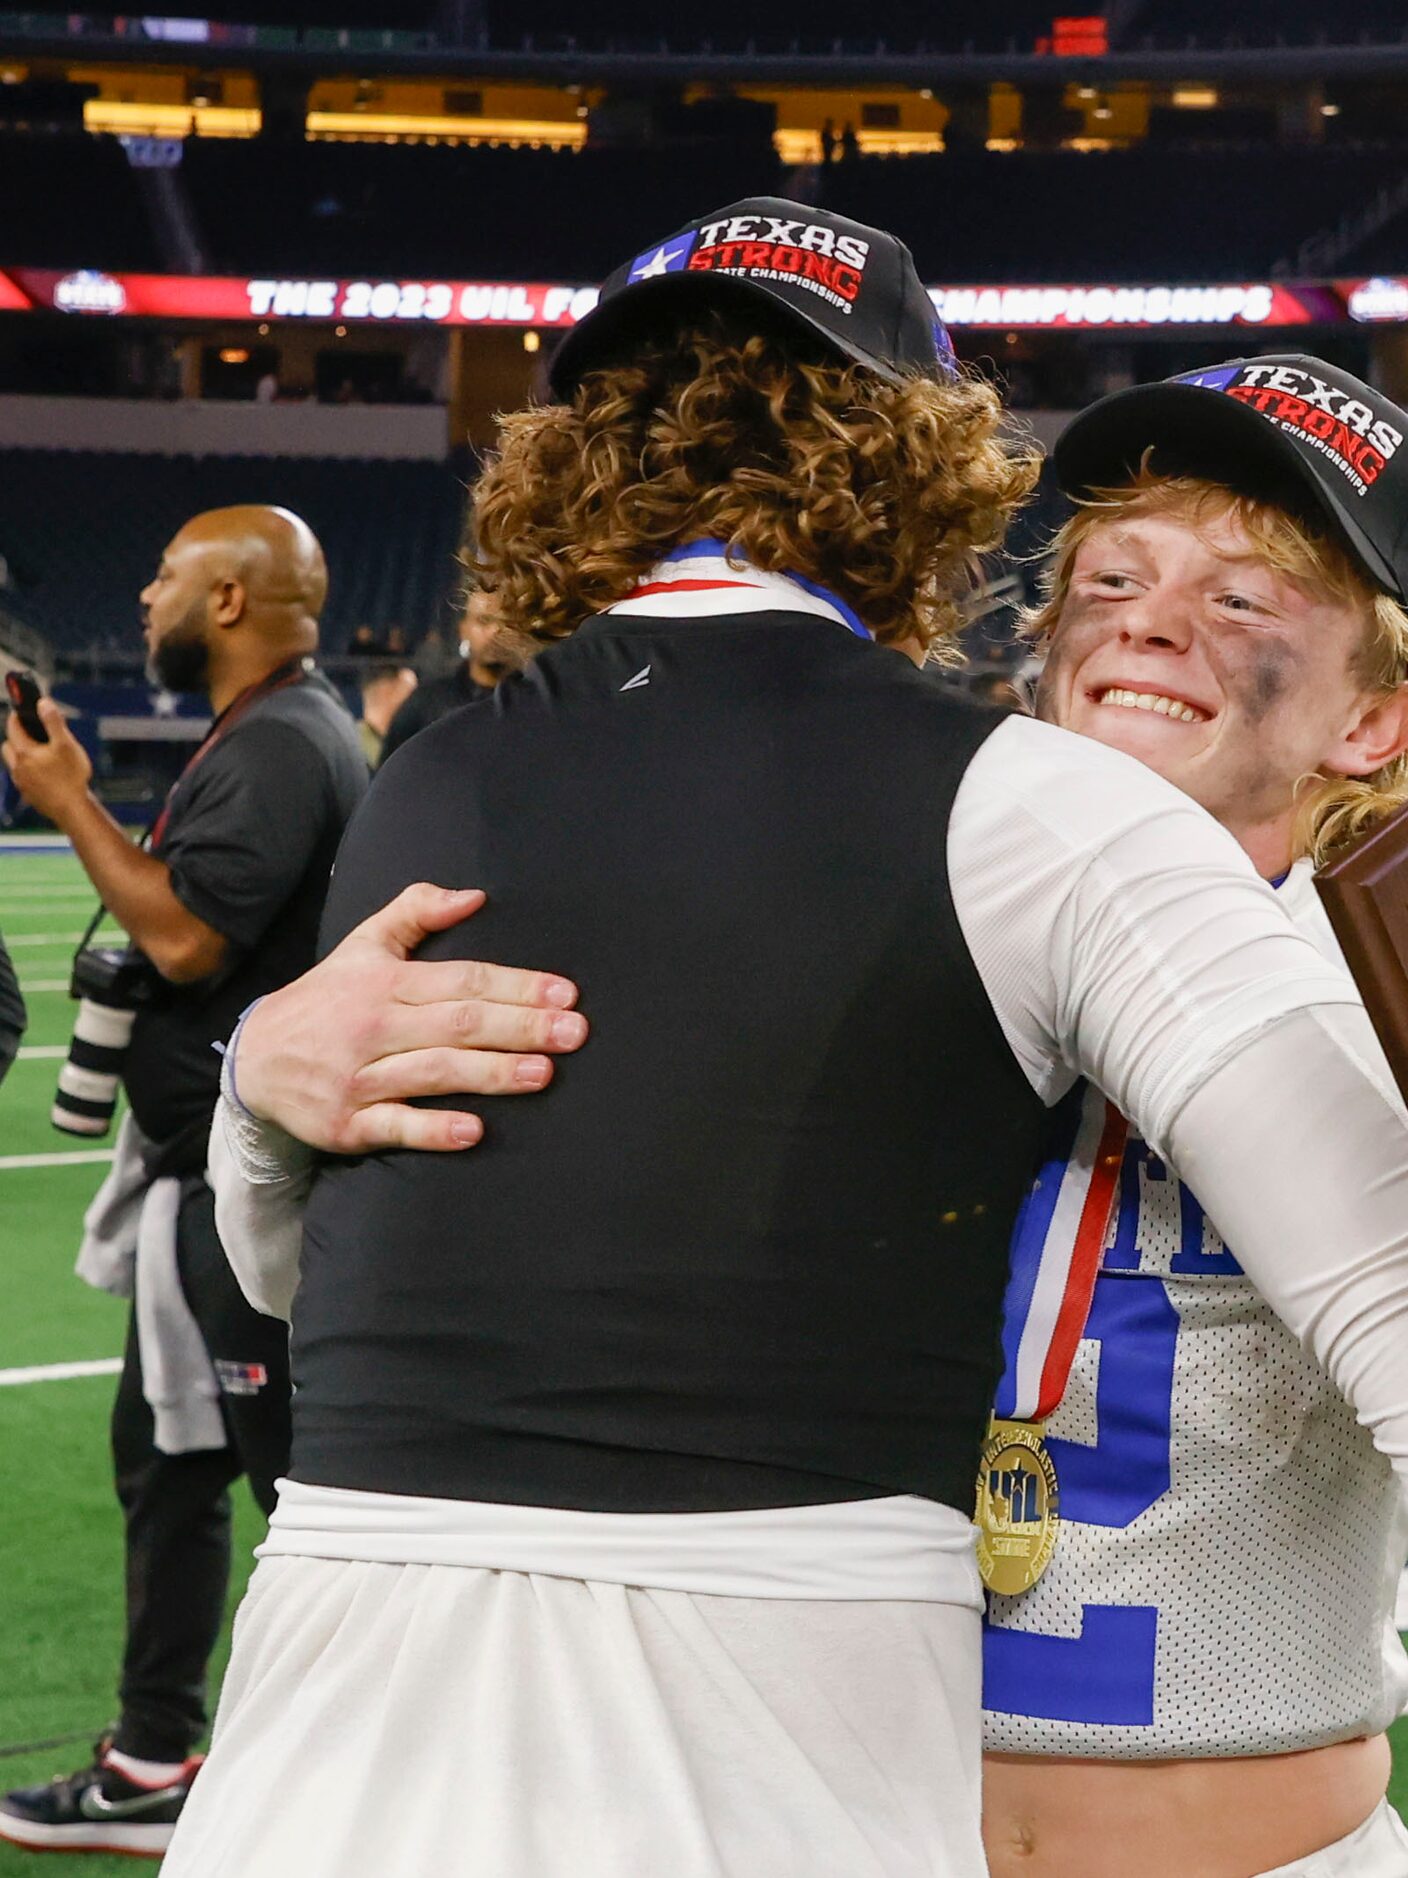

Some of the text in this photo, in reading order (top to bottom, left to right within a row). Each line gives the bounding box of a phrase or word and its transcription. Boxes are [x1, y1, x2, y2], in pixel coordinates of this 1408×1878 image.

[688, 240, 863, 301] STRONG
[699, 215, 870, 271] TEXAS
[247, 280, 338, 317] THE
[341, 281, 453, 321] 2023
[459, 286, 536, 322] UIL
[750, 267, 853, 315] CHAMPIONSHIPS
[1226, 386, 1386, 486] STRONG
[1238, 365, 1404, 460] TEXAS
[1281, 421, 1369, 497] CHAMPIONSHIPS
